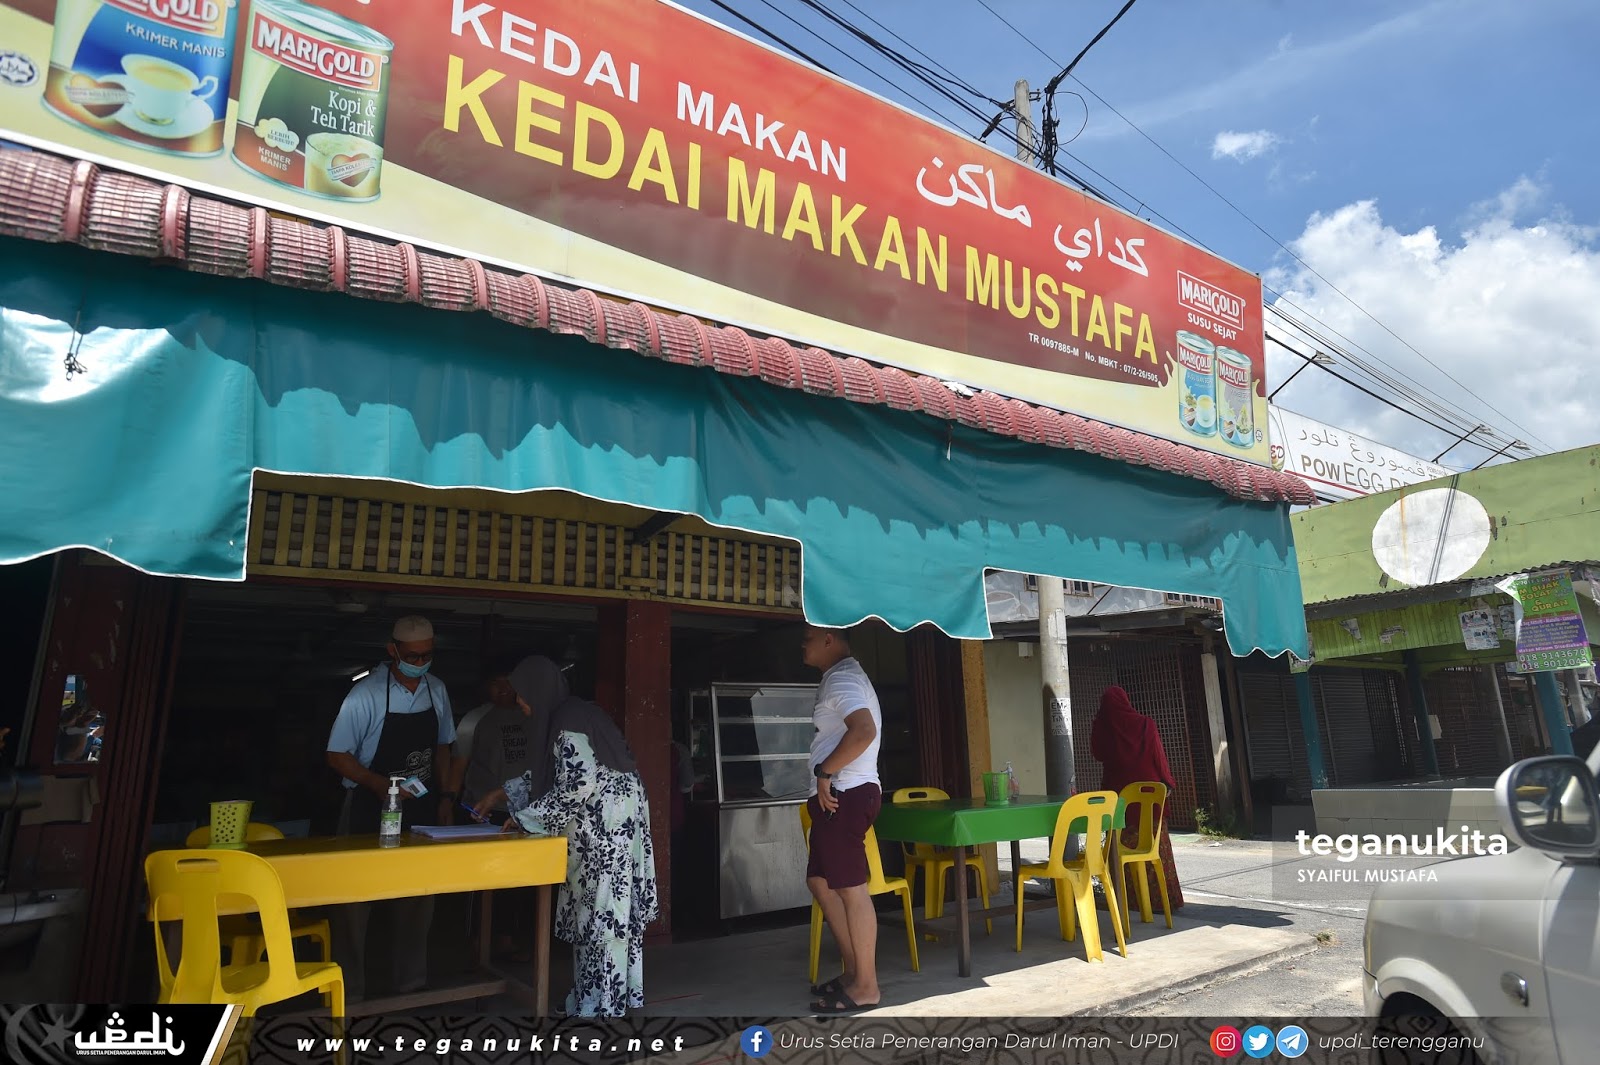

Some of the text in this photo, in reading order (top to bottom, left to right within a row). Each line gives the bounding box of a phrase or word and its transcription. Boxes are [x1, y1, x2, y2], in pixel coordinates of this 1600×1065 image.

[125, 21, 226, 58] KRIMER MANIS
[257, 19, 375, 77] MARIGOLD
[328, 90, 377, 117] Kopi &
[450, 0, 846, 182] KEDAI MAKAN
[310, 105, 374, 137] Teh Tarik
[258, 146, 291, 165] KRIMER
[260, 155, 288, 171] MANIS
[443, 54, 1158, 364] KEDAI MAKAN MUSTAFA
[1181, 277, 1240, 318] MARIGOLD
[1187, 312, 1237, 341] SUSU SEJAT
[1028, 332, 1040, 344] TR
[1041, 338, 1079, 357] 0097885-M
[1085, 351, 1097, 363] No.
[1098, 355, 1118, 370] MBKT
[1179, 347, 1212, 373] MARIGOLD
[1219, 363, 1249, 387] MARIGOLD
[1520, 589, 1551, 601] SOLAT
[1532, 580, 1559, 593] BIJAK
[1531, 599, 1568, 612] QURAN
[1519, 648, 1586, 662] 018-9143670
